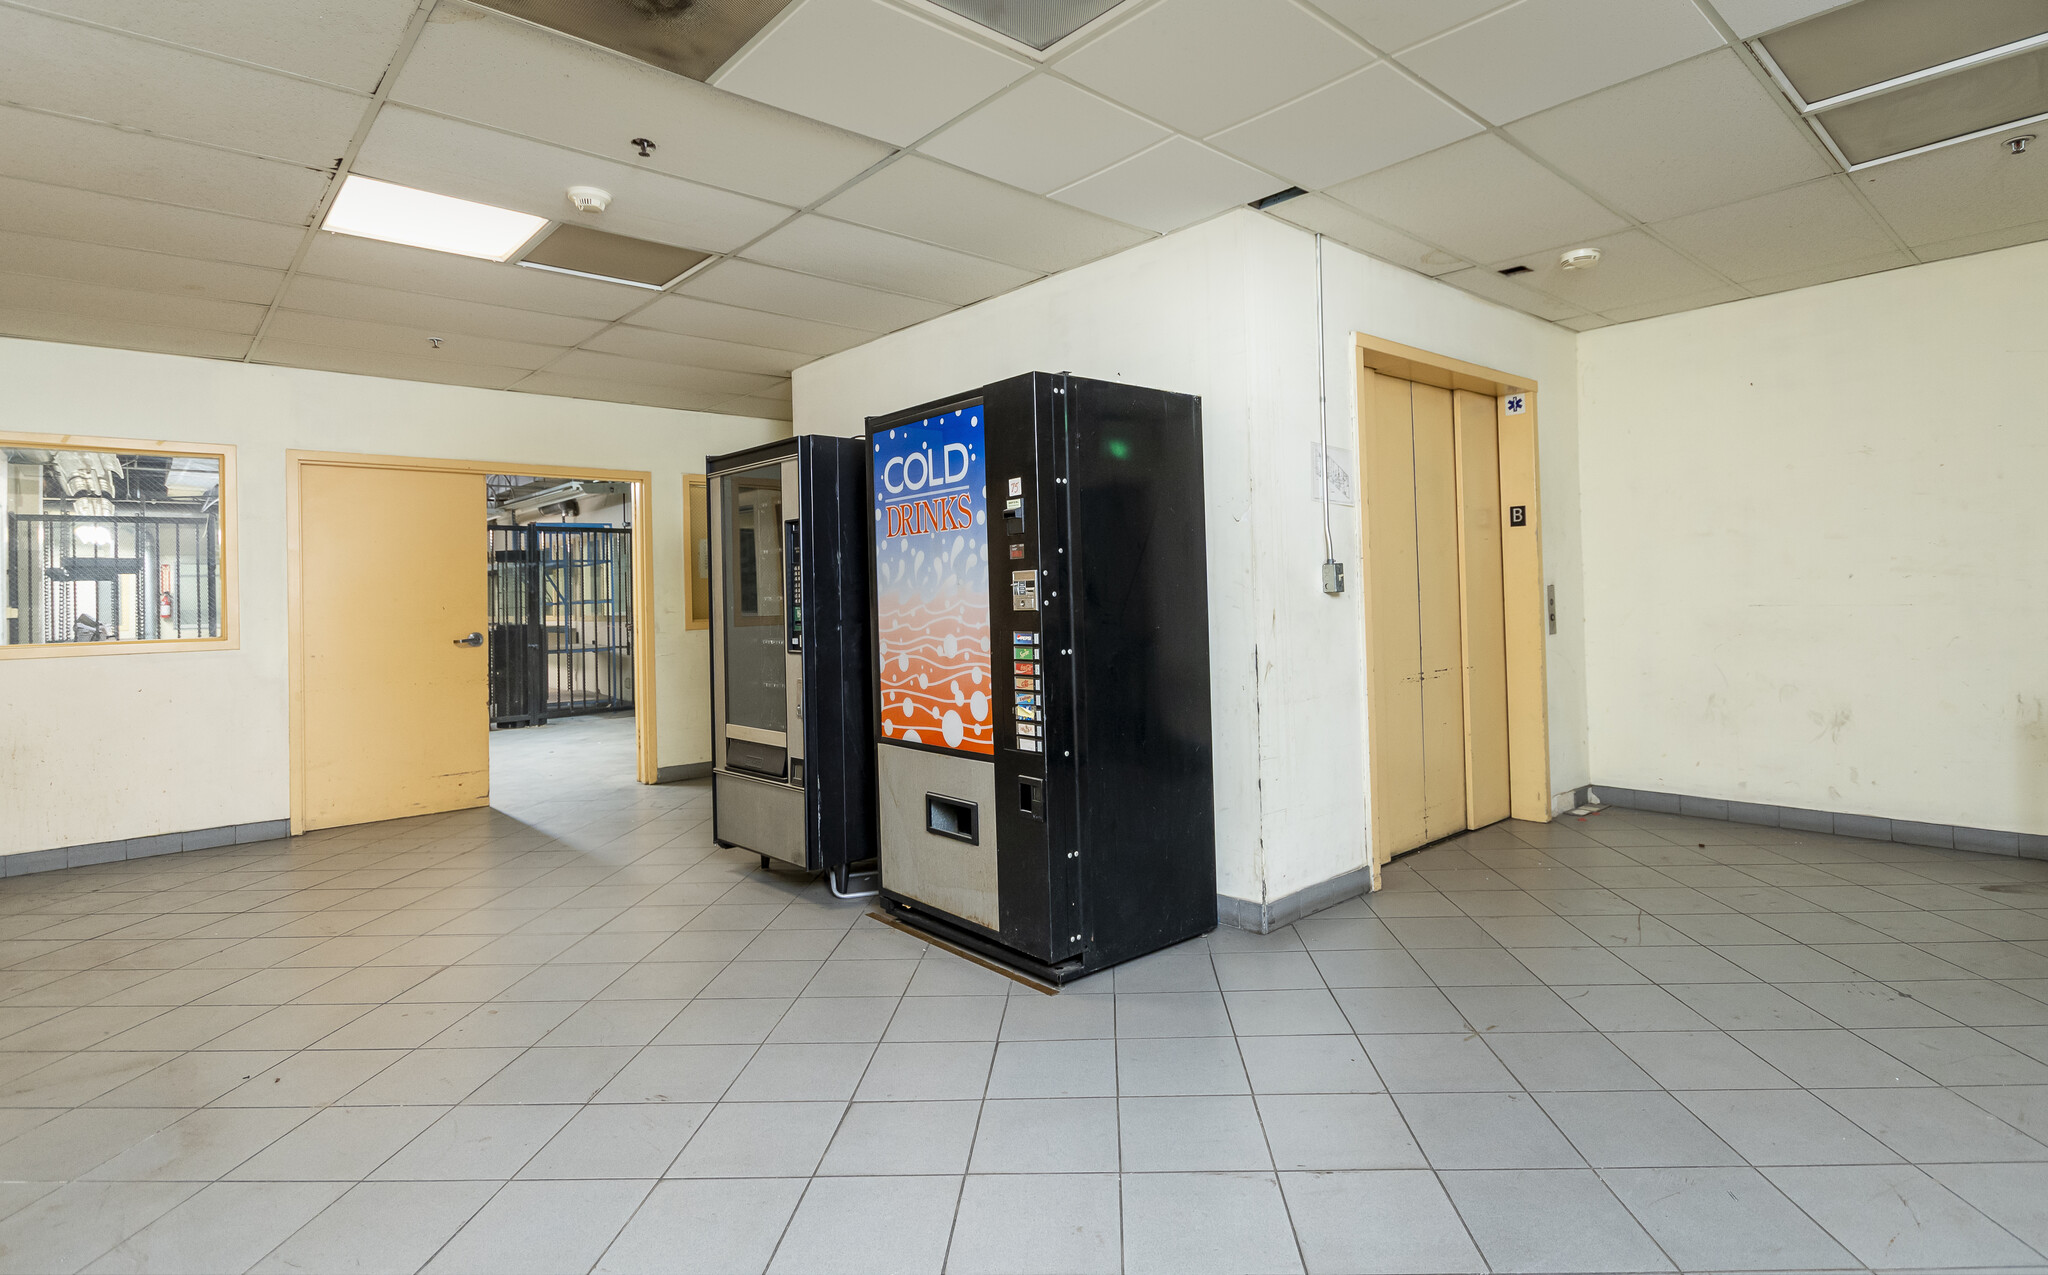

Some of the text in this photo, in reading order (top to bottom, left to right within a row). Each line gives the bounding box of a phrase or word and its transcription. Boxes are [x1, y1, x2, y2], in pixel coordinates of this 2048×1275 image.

[884, 442, 969, 494] COLD
[885, 492, 973, 539] DRINKS
[1512, 508, 1523, 522] B
